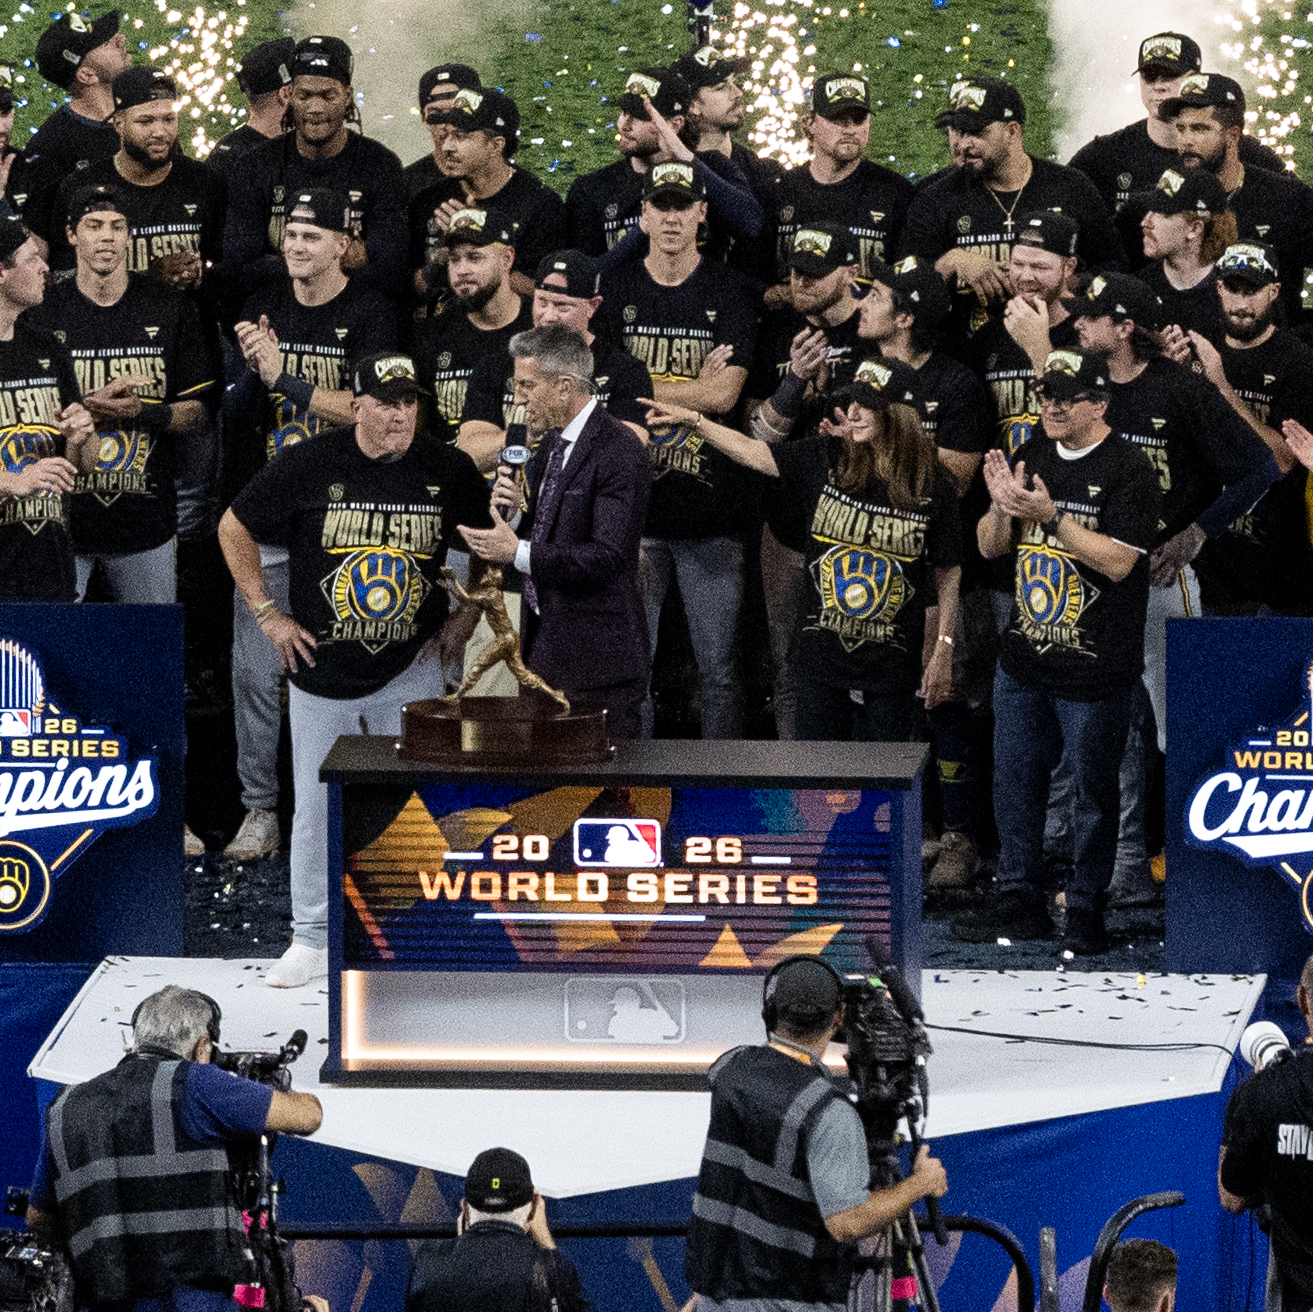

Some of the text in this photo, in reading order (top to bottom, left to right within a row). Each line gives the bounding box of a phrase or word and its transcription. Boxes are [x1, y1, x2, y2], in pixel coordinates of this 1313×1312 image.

[322, 510, 443, 551] WORLD SERIES
[810, 491, 927, 558] WORLD SERIES
[45, 718, 77, 733] 26
[1276, 730, 1309, 747] 20
[11, 740, 120, 757] SERIES
[491, 835, 743, 864] 20 26
[418, 871, 819, 905] WORLD SERIES
[1278, 1124, 1309, 1160] STAY
